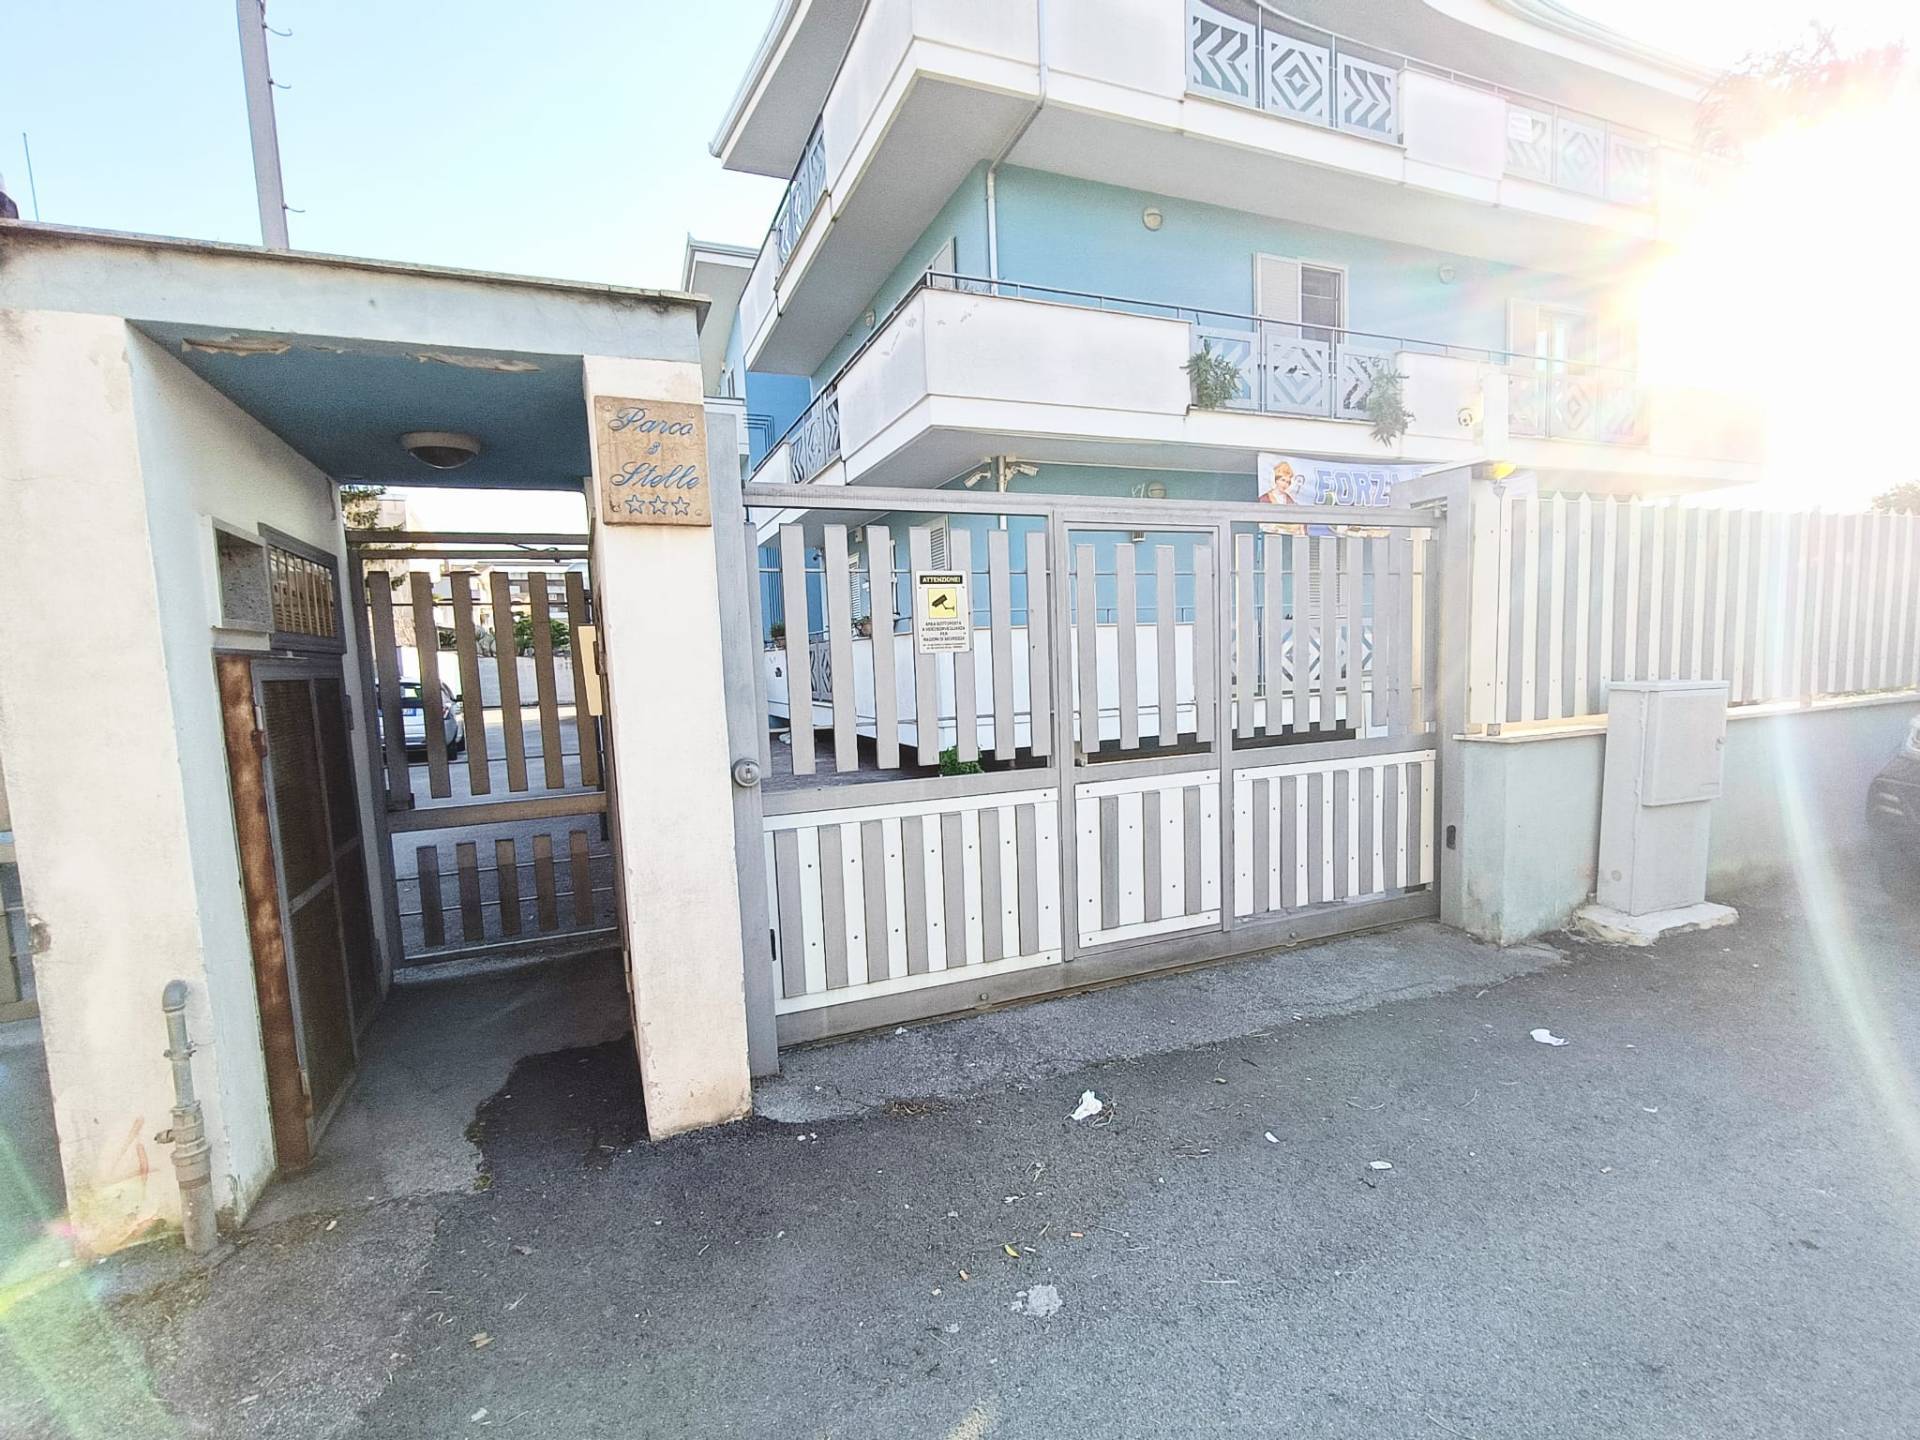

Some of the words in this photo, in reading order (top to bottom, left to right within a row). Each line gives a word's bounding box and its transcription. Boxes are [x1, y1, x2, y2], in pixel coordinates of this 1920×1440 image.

[609, 407, 692, 435] Parco
[647, 441, 661, 455] 3
[609, 461, 700, 490] Stelle
[1314, 468, 1400, 506] FORZ
